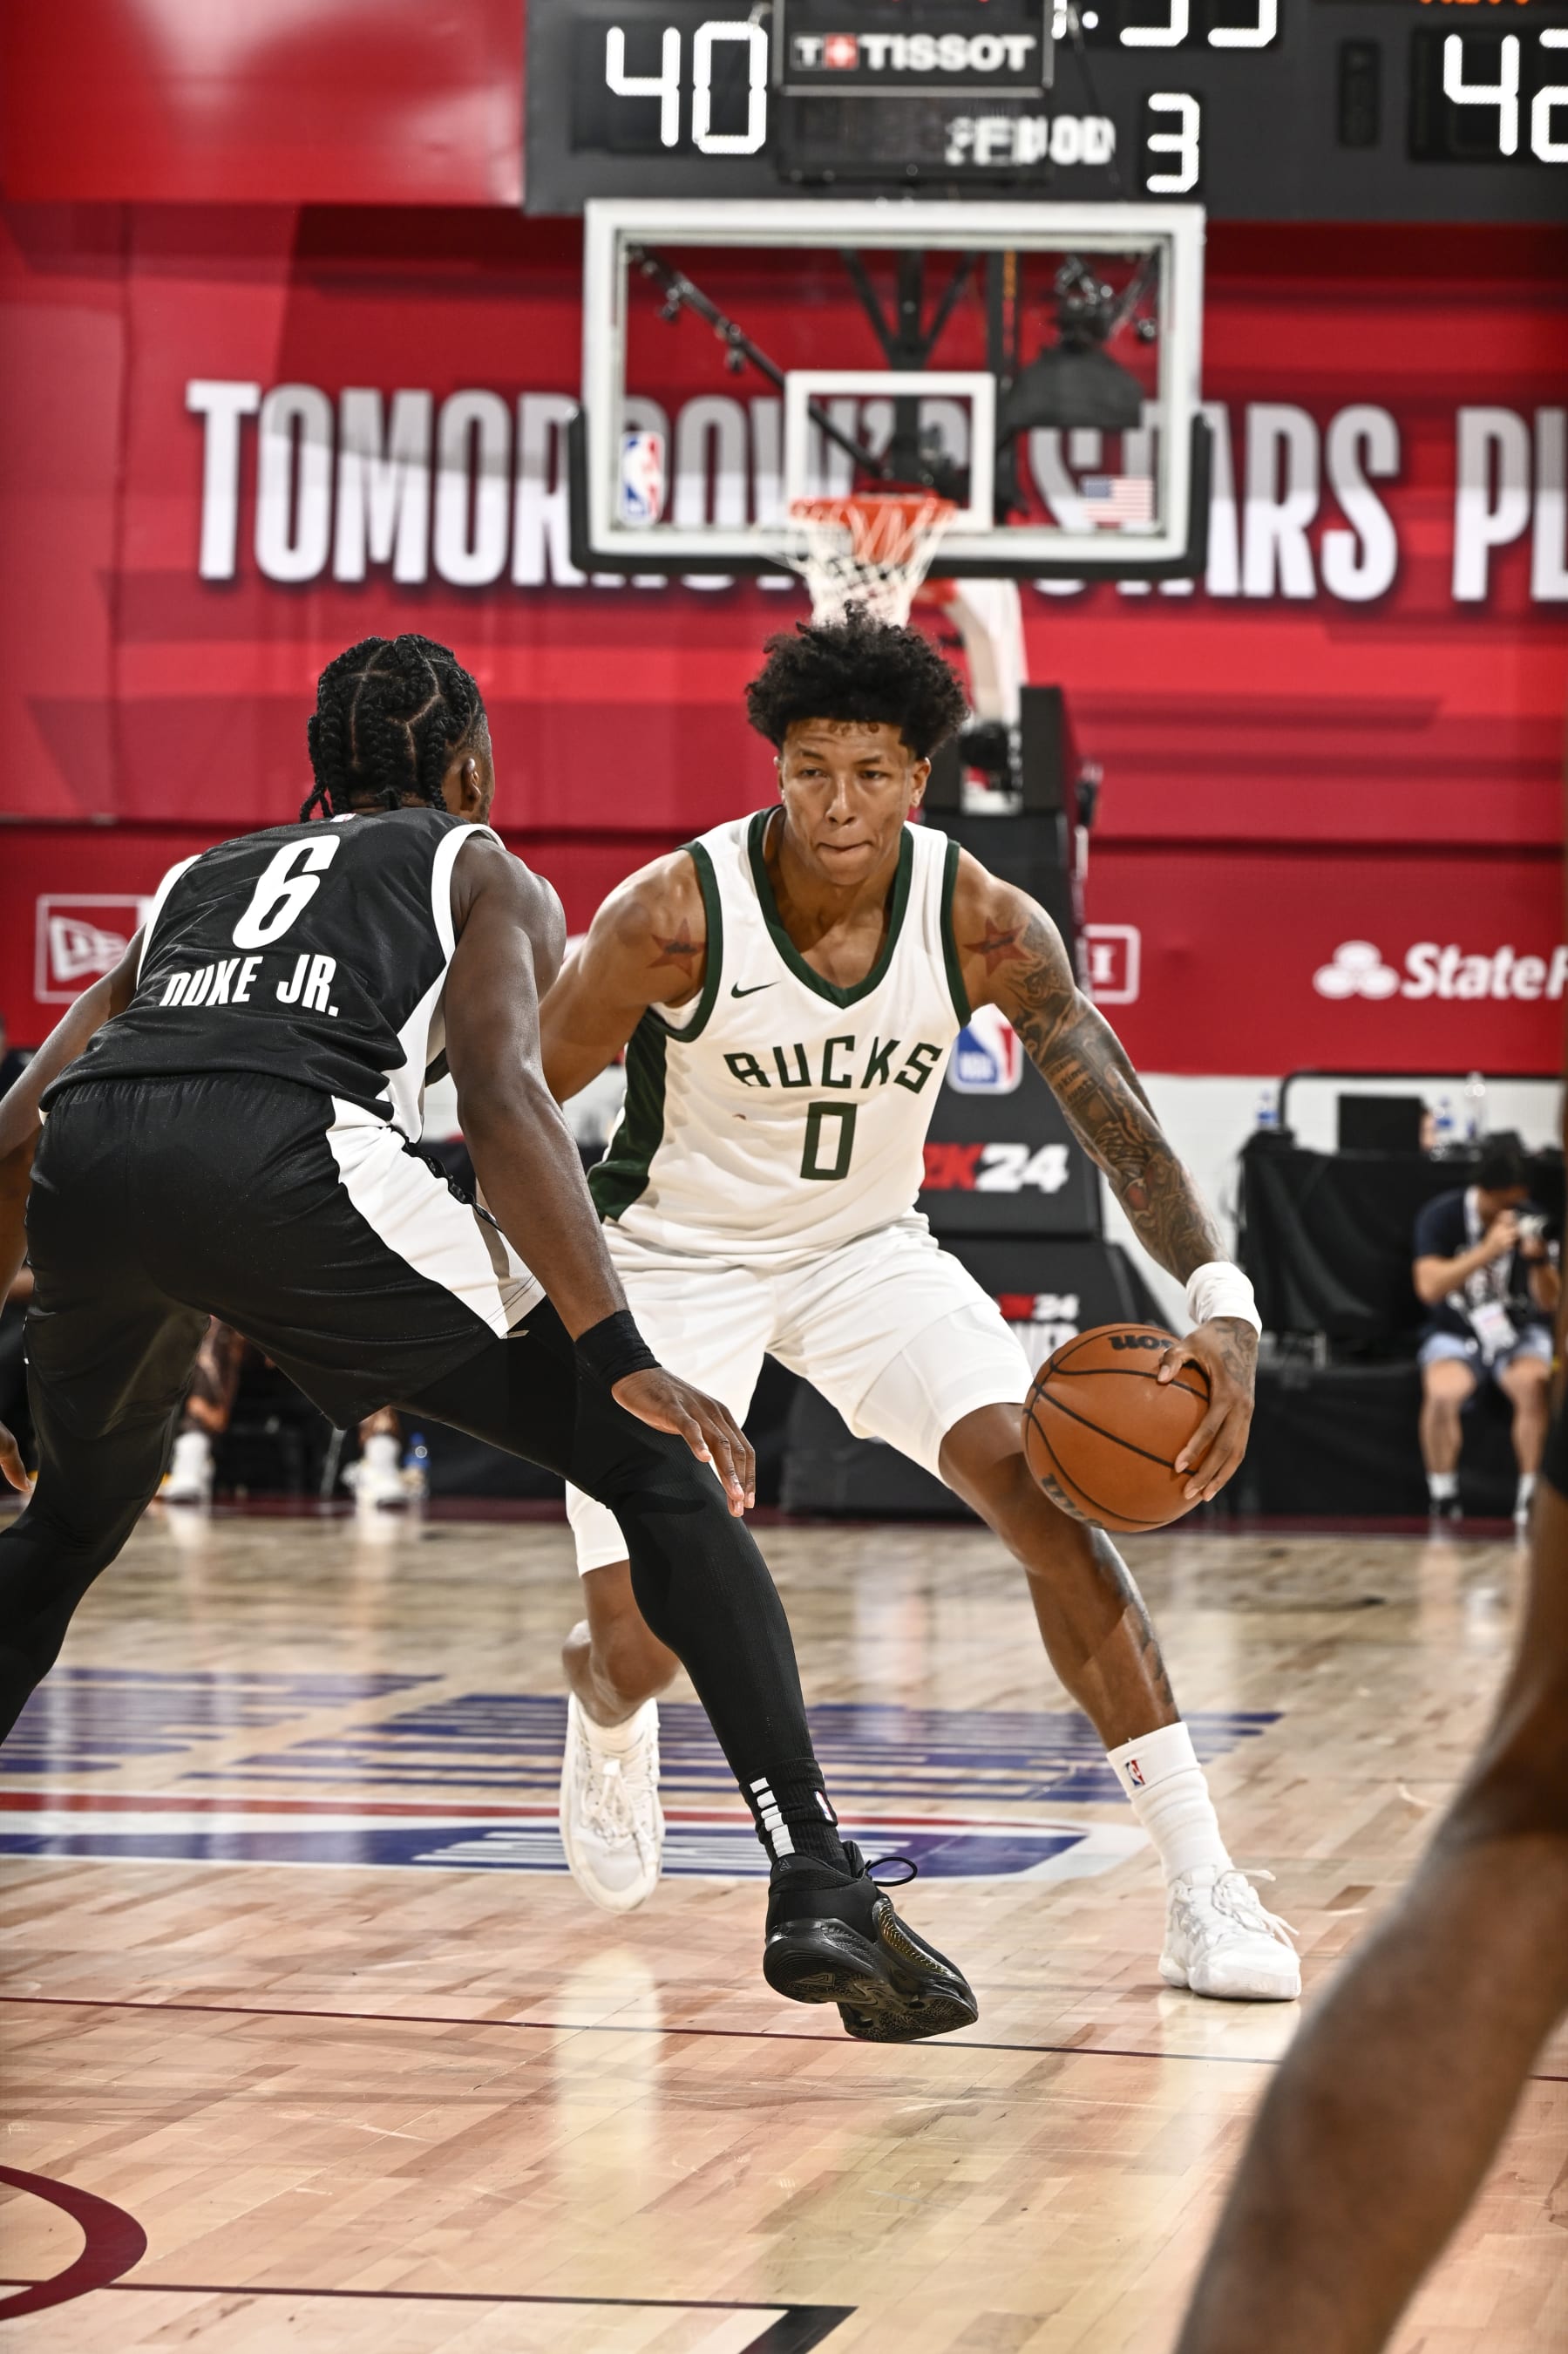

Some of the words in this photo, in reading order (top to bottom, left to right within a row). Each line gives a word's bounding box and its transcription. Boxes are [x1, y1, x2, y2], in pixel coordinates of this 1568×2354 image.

[606, 21, 768, 154] 40
[859, 34, 1036, 71] TISSOT
[1146, 93, 1200, 193] 3
[233, 834, 341, 949] 6
[159, 956, 264, 1006] DUKE
[276, 954, 339, 1017] JR.
[723, 1035, 944, 1094] BUCKS
[799, 1101, 859, 1180] 0
